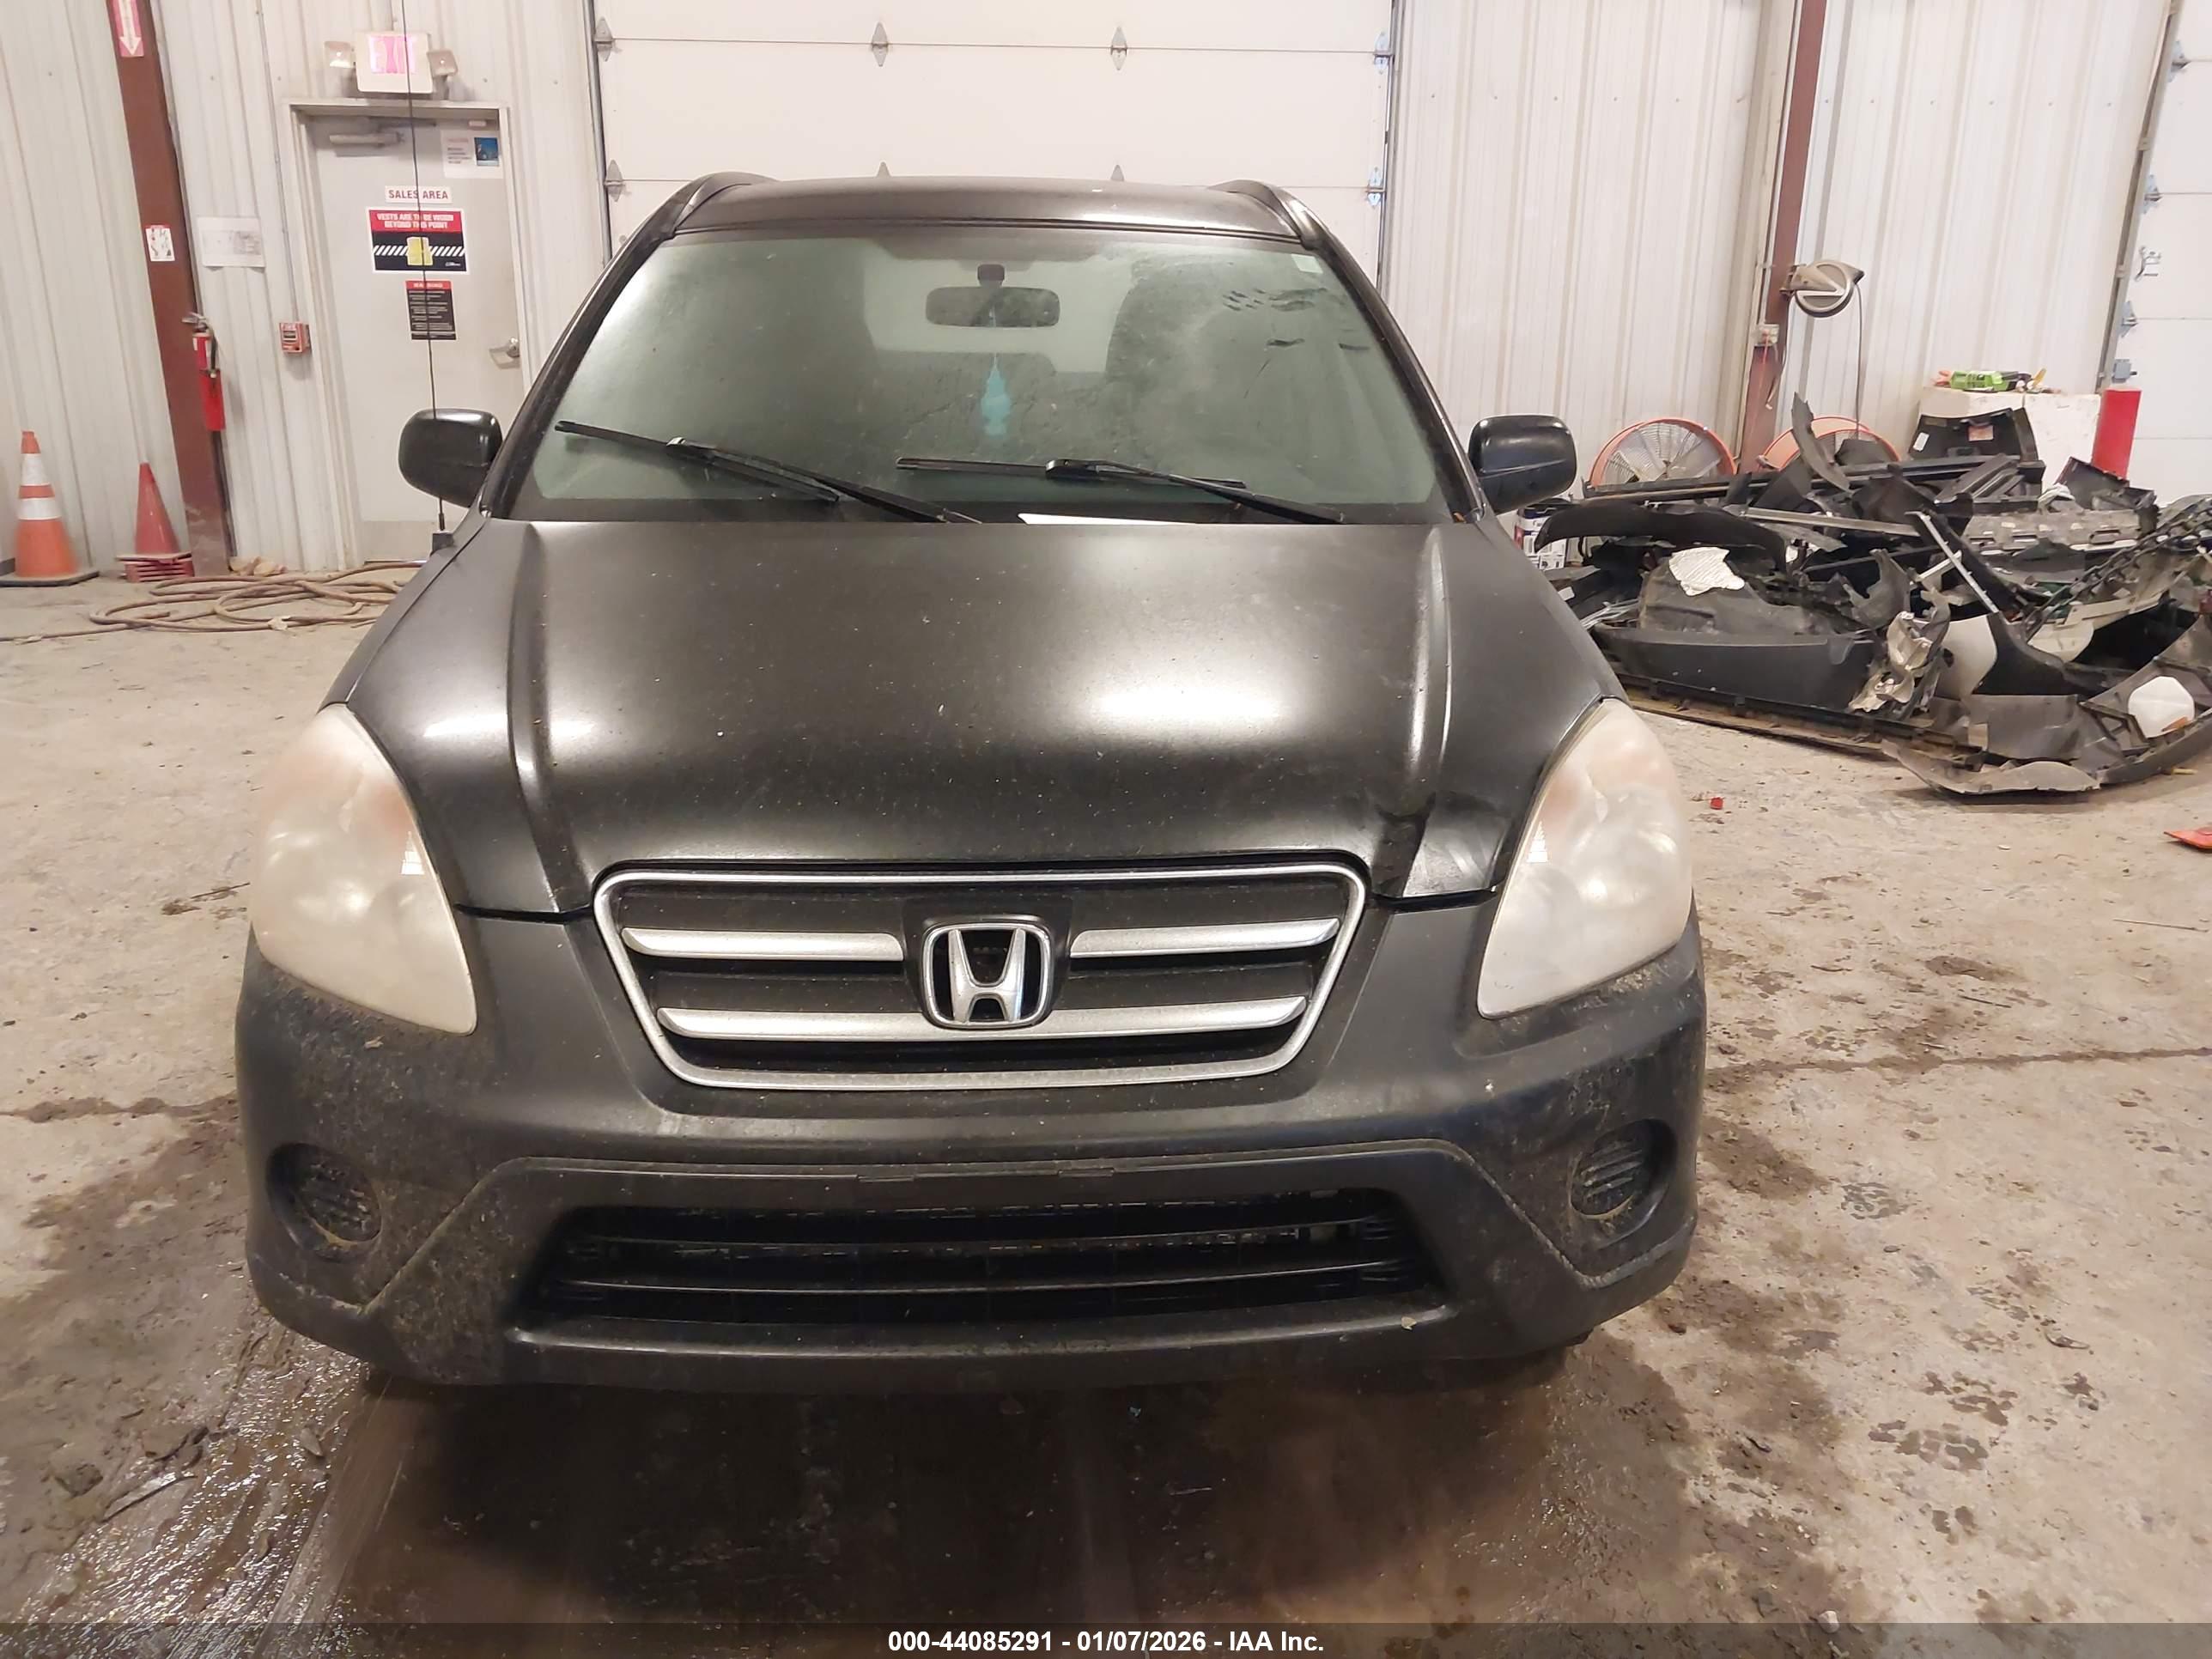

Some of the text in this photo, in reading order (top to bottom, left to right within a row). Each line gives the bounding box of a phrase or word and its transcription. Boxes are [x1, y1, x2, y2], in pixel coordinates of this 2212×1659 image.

[370, 34, 416, 75] EXIT
[388, 189, 448, 199] SALES AREA
